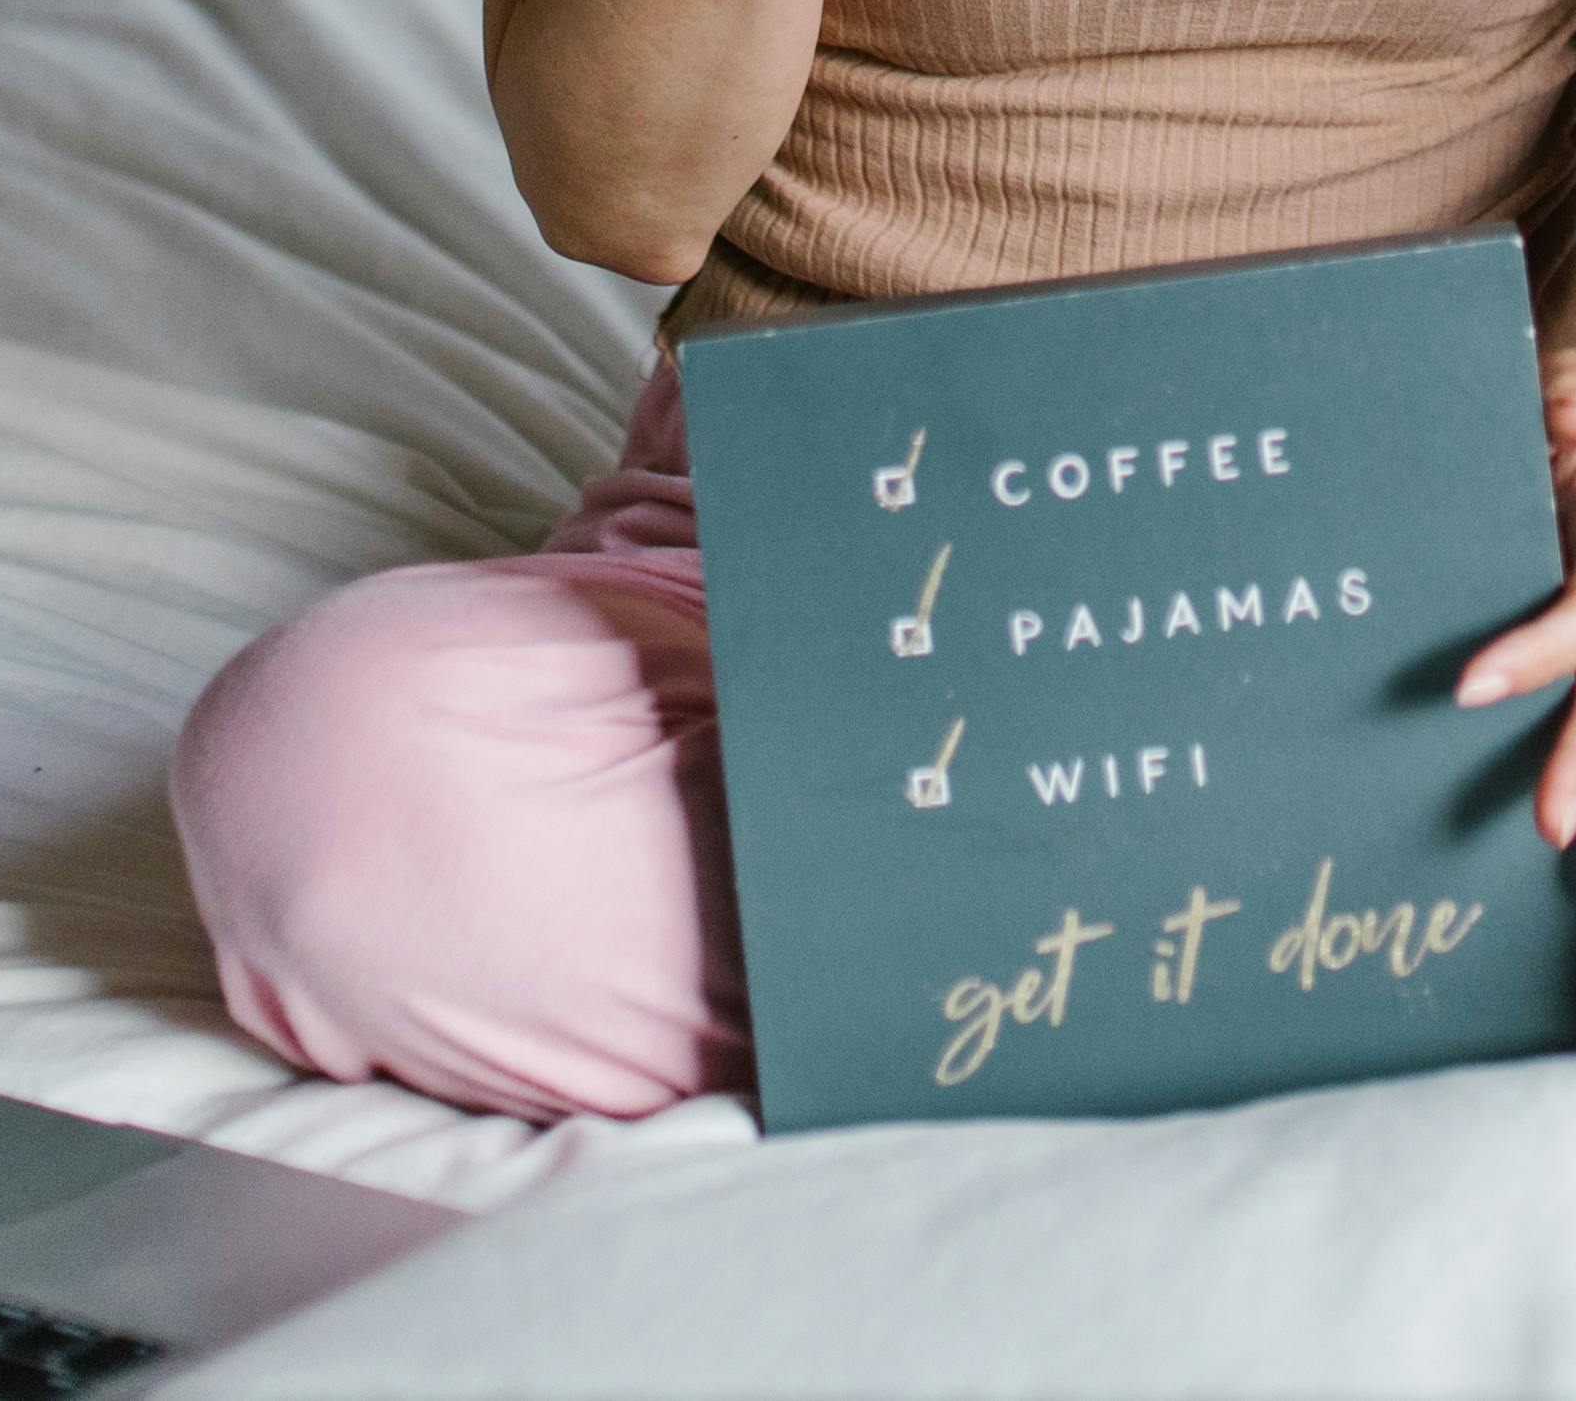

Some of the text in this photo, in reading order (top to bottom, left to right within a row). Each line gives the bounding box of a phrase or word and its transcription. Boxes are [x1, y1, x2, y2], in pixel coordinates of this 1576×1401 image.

[989, 426, 1293, 509] COFFEE
[1007, 566, 1374, 656] PAJAMAS
[1027, 743, 1210, 806] WIFI
[934, 855, 1484, 1087] get it done
